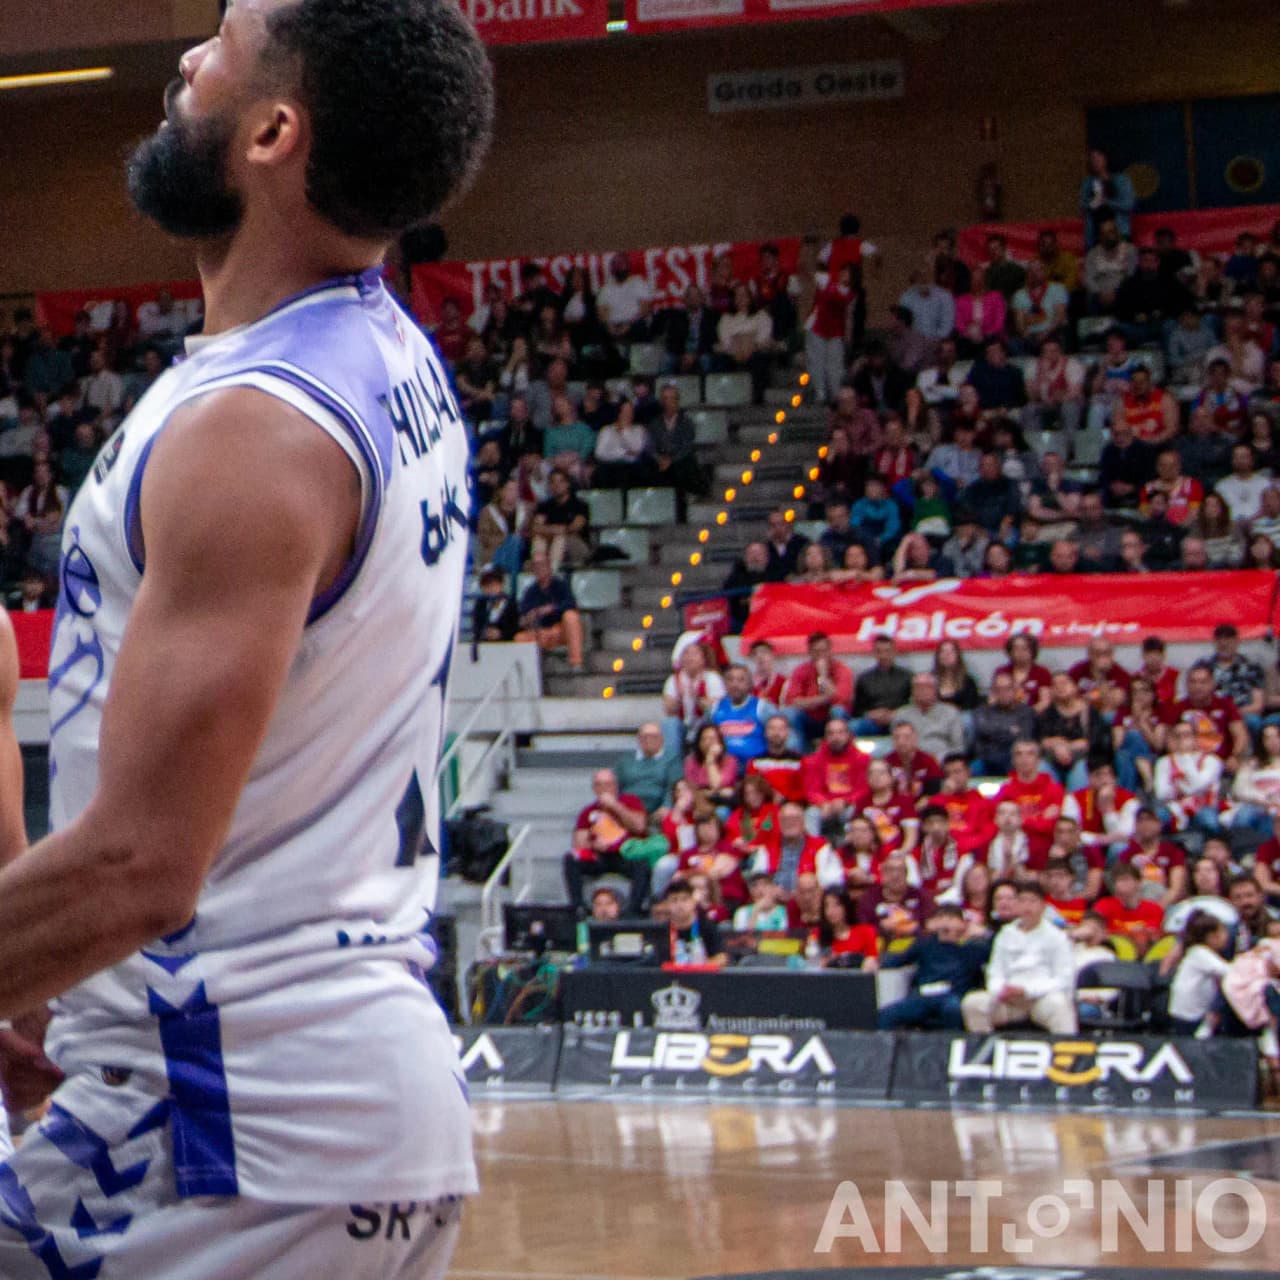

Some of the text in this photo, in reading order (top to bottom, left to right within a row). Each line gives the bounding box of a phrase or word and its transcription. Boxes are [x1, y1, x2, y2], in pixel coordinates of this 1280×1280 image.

[715, 70, 896, 101] Grada Oeste
[857, 611, 1044, 641] Halcón
[611, 1031, 837, 1077] LIBERA
[947, 1038, 1195, 1086] LIBERA
